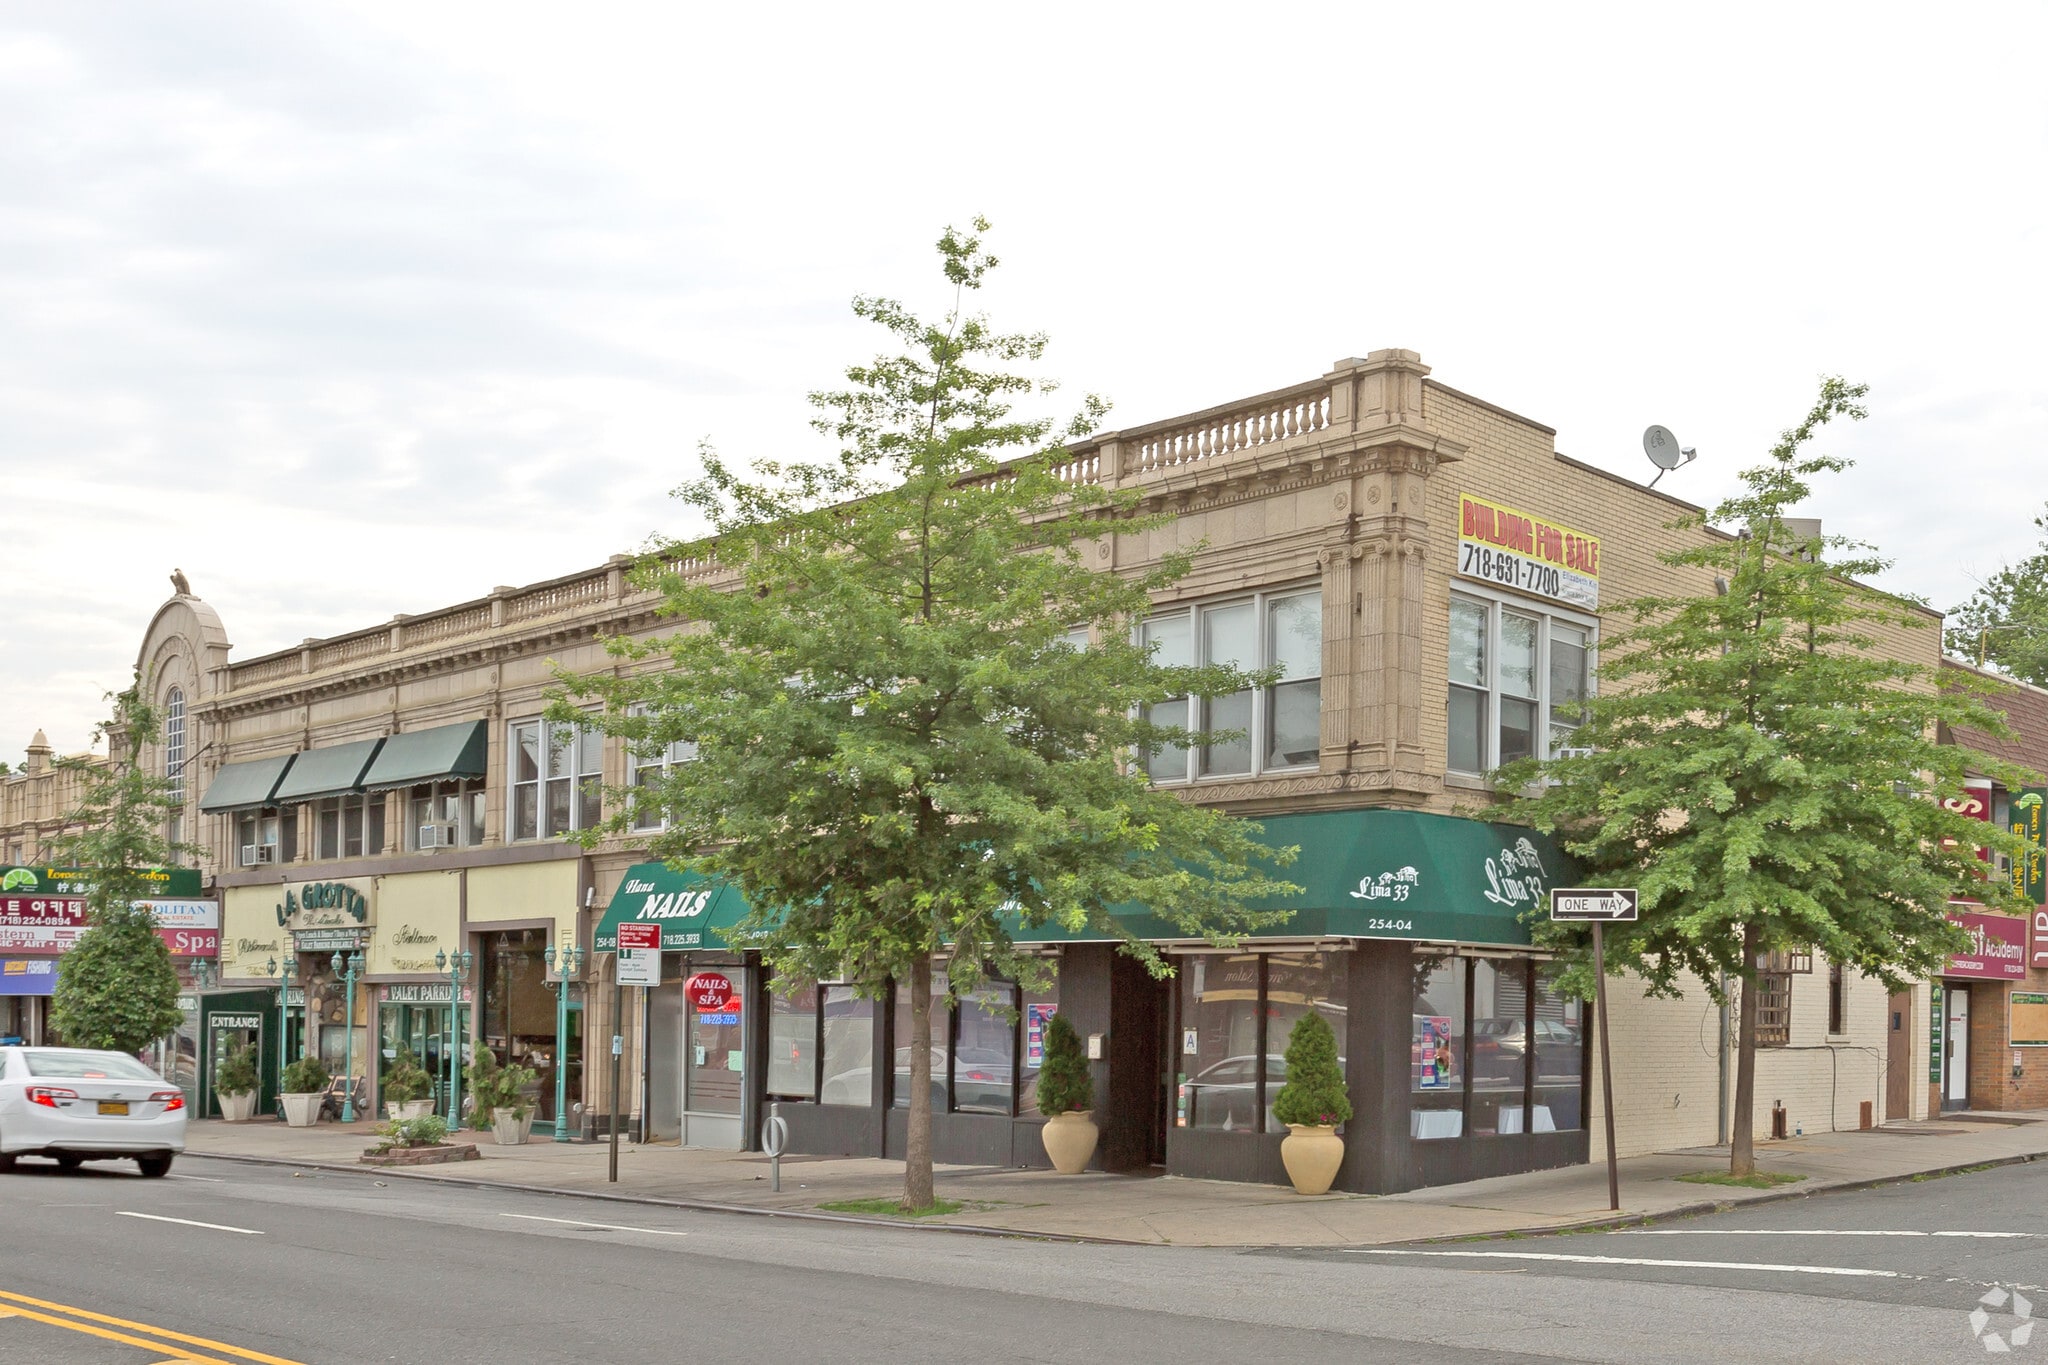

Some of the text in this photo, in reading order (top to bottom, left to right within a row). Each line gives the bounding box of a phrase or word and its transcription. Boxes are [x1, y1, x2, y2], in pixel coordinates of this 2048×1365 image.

[1463, 499, 1598, 575] BUILDING FOR SALE
[1463, 543, 1560, 597] 718-631-7700
[625, 879, 656, 894] Hana
[1349, 875, 1410, 901] Lima 33
[1483, 857, 1545, 909] Lima 33
[276, 881, 365, 927] LA GROTTA
[636, 890, 712, 919] NAILS
[1564, 899, 1625, 910] ONE WAY
[1369, 918, 1413, 931] 254-04
[175, 931, 215, 953] Spa
[694, 979, 729, 989] NAILS
[391, 986, 419, 1001] VALET
[698, 994, 723, 1005] SPA
[211, 1016, 259, 1028] ENTRANCE
[1186, 1034, 1195, 1048] A
